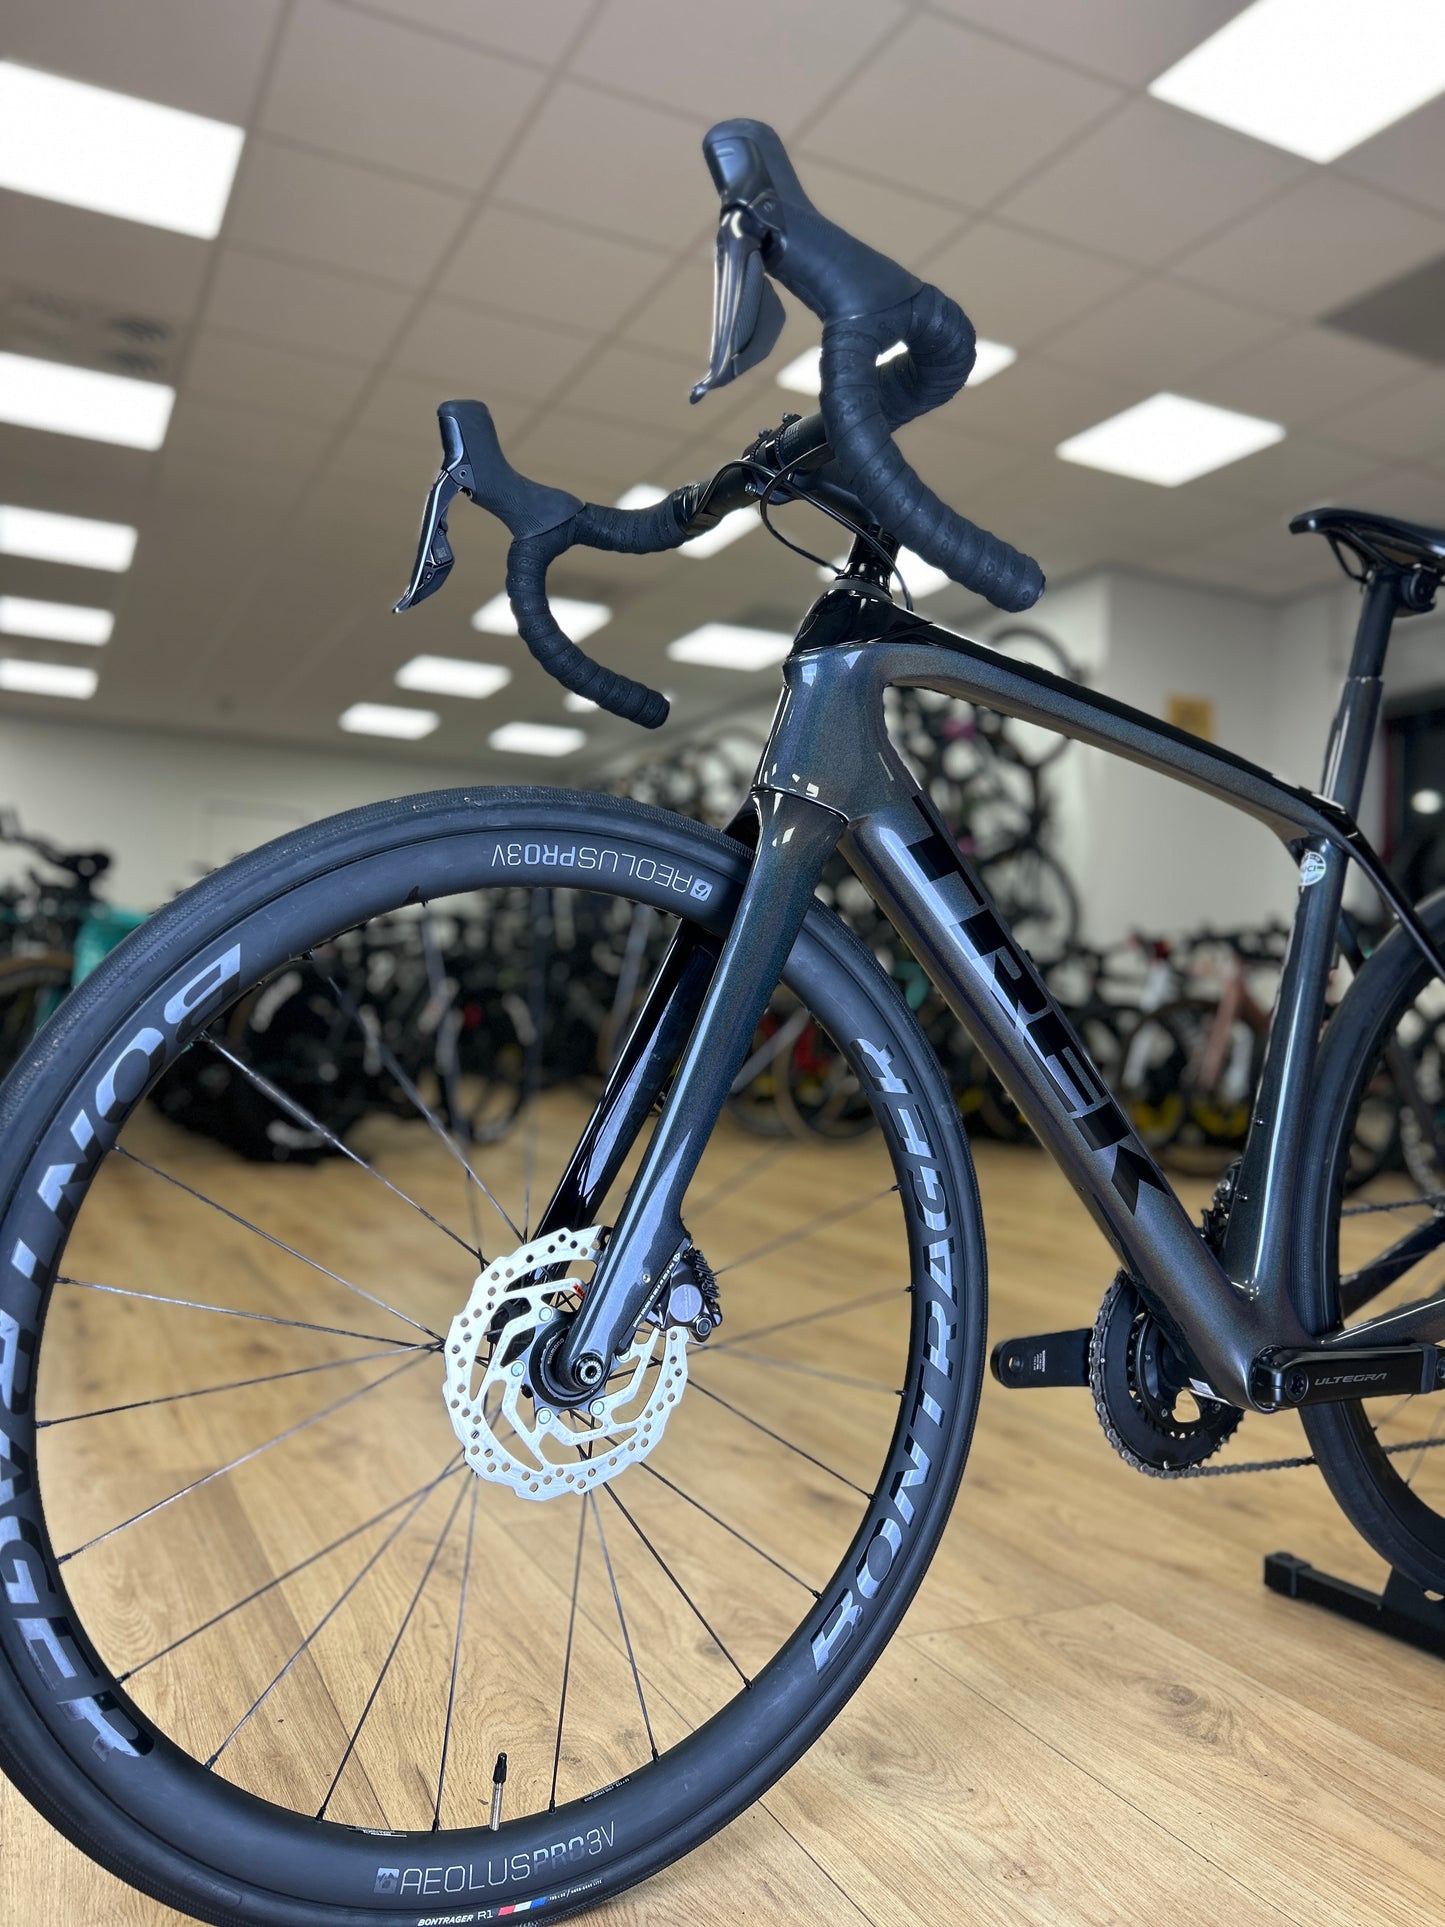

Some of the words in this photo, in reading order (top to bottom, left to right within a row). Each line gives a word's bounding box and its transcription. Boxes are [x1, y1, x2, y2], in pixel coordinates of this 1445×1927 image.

[903, 795, 1171, 1216] TREK
[811, 1038, 957, 1674] BONTRAGER
[1314, 1373, 1388, 1386] ULTEGRA
[417, 1914, 474, 1927] BONTRAGER
[477, 1909, 493, 1920] R1
